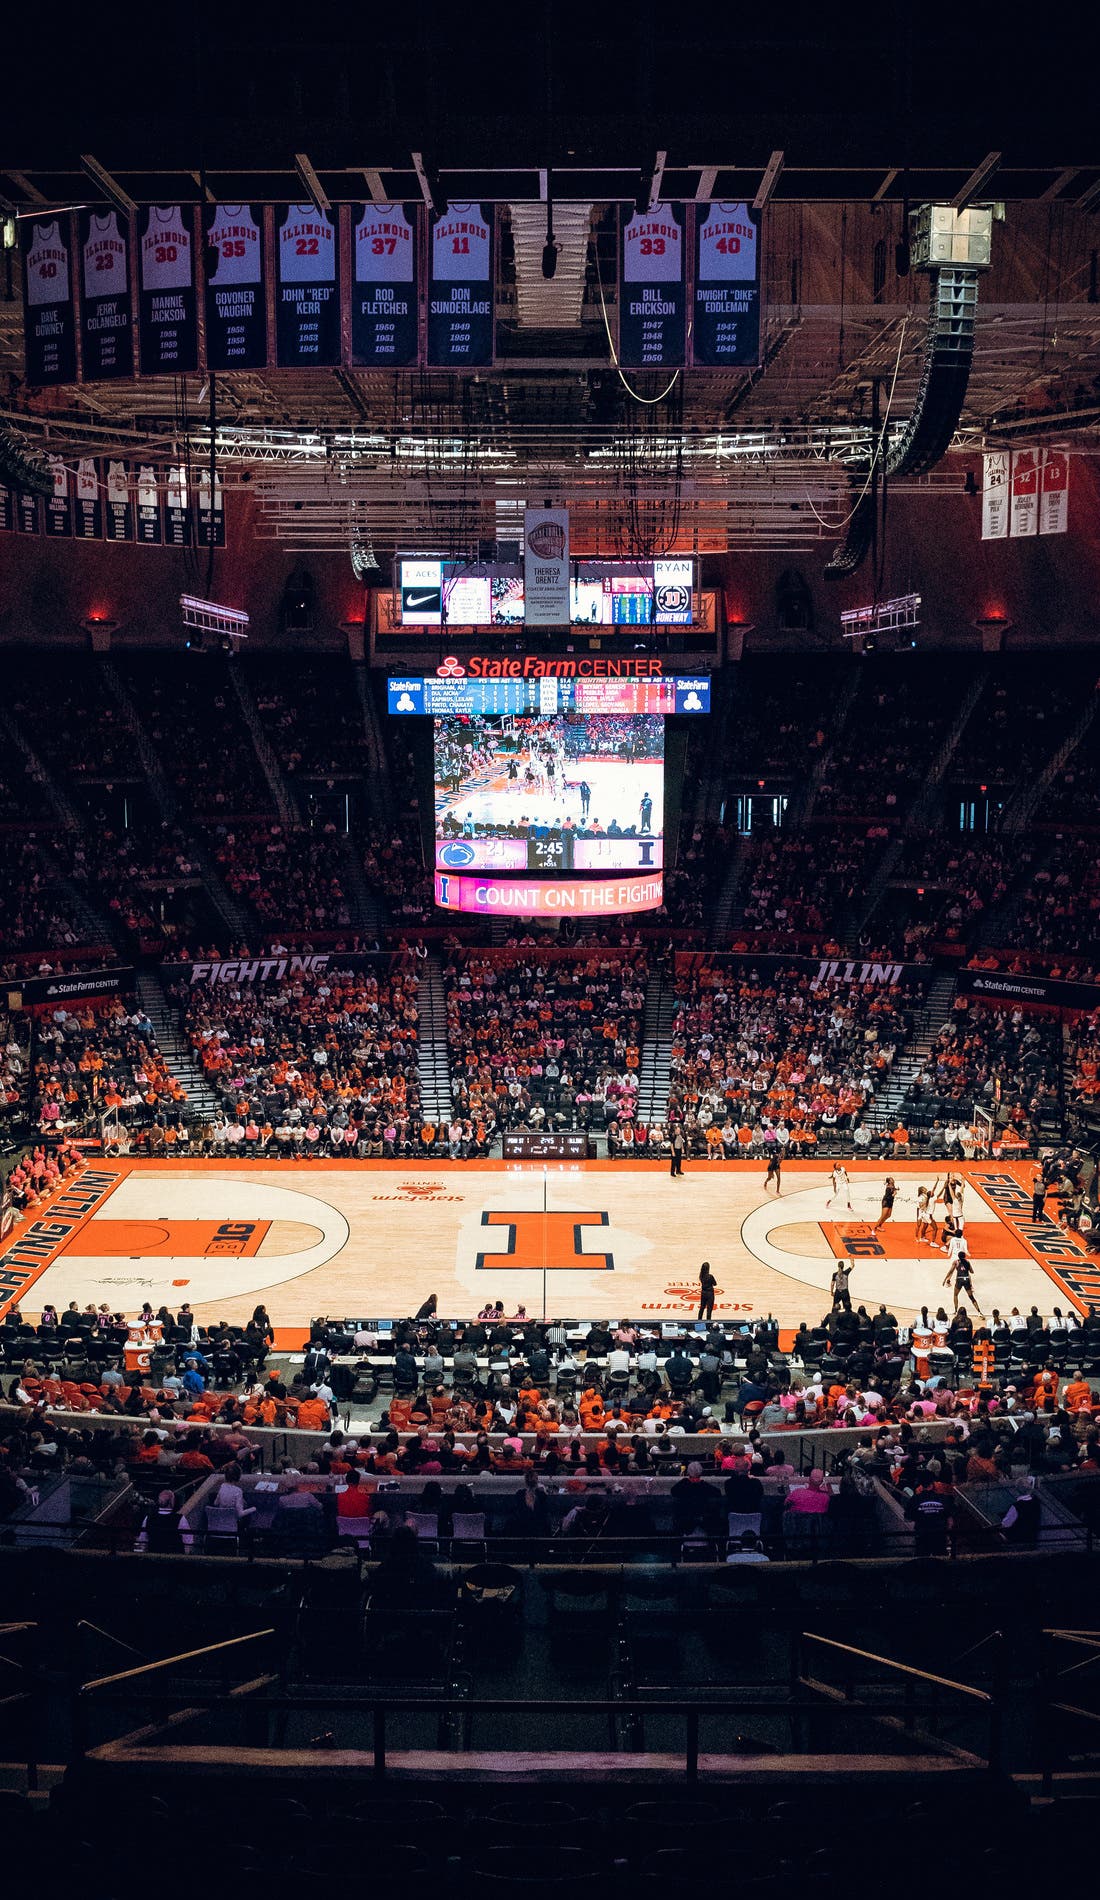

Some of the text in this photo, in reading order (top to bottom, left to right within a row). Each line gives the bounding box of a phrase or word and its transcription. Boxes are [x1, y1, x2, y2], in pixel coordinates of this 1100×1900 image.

[222, 240, 246, 258] 35
[295, 238, 320, 255] 22
[371, 238, 397, 255] 37
[452, 237, 470, 254] 11
[640, 238, 666, 256] 33
[716, 238, 741, 254] 40
[155, 246, 178, 263] 30
[96, 254, 114, 271] 23
[39, 262, 57, 279] 40
[215, 290, 255, 306] GOVONER
[282, 288, 304, 302] JOHN
[375, 288, 394, 301] ROD
[451, 288, 470, 300] DON
[642, 289, 662, 302] BILL
[697, 290, 728, 301] DWIGHT
[96, 302, 118, 315] JERRY
[152, 296, 184, 310] MANNIE
[296, 302, 320, 314] KERR
[361, 302, 408, 315] FLETCHER
[430, 301, 490, 314] SUNDERLAGE
[630, 302, 676, 316] ERICKSON
[705, 302, 748, 313] EDDLEMAN
[41, 310, 58, 324] DAVE
[151, 308, 186, 323] JACKSON
[218, 304, 252, 318] VAUGHN
[36, 322, 64, 337] DOWNEY
[87, 314, 127, 331] COLANGELO
[990, 474, 1001, 486] 24
[1020, 472, 1030, 483] 32
[534, 568, 560, 576] THERESA
[656, 563, 690, 572] RYAN
[536, 576, 559, 584] ORENTZ
[578, 659, 663, 676] CENTER
[536, 842, 564, 854] 2:45
[548, 854, 552, 862] 2
[476, 886, 541, 907] COUNT
[544, 888, 576, 907] ON
[580, 888, 614, 906] THE
[190, 955, 330, 986] FIGHTING
[816, 961, 904, 985] ILLINI
[96, 979, 120, 988] CENTER
[1021, 987, 1046, 996] CENTER
[513, 1146, 522, 1154] 24
[542, 1146, 548, 1154] 2
[558, 1146, 564, 1154] 2
[570, 1146, 580, 1154] 44
